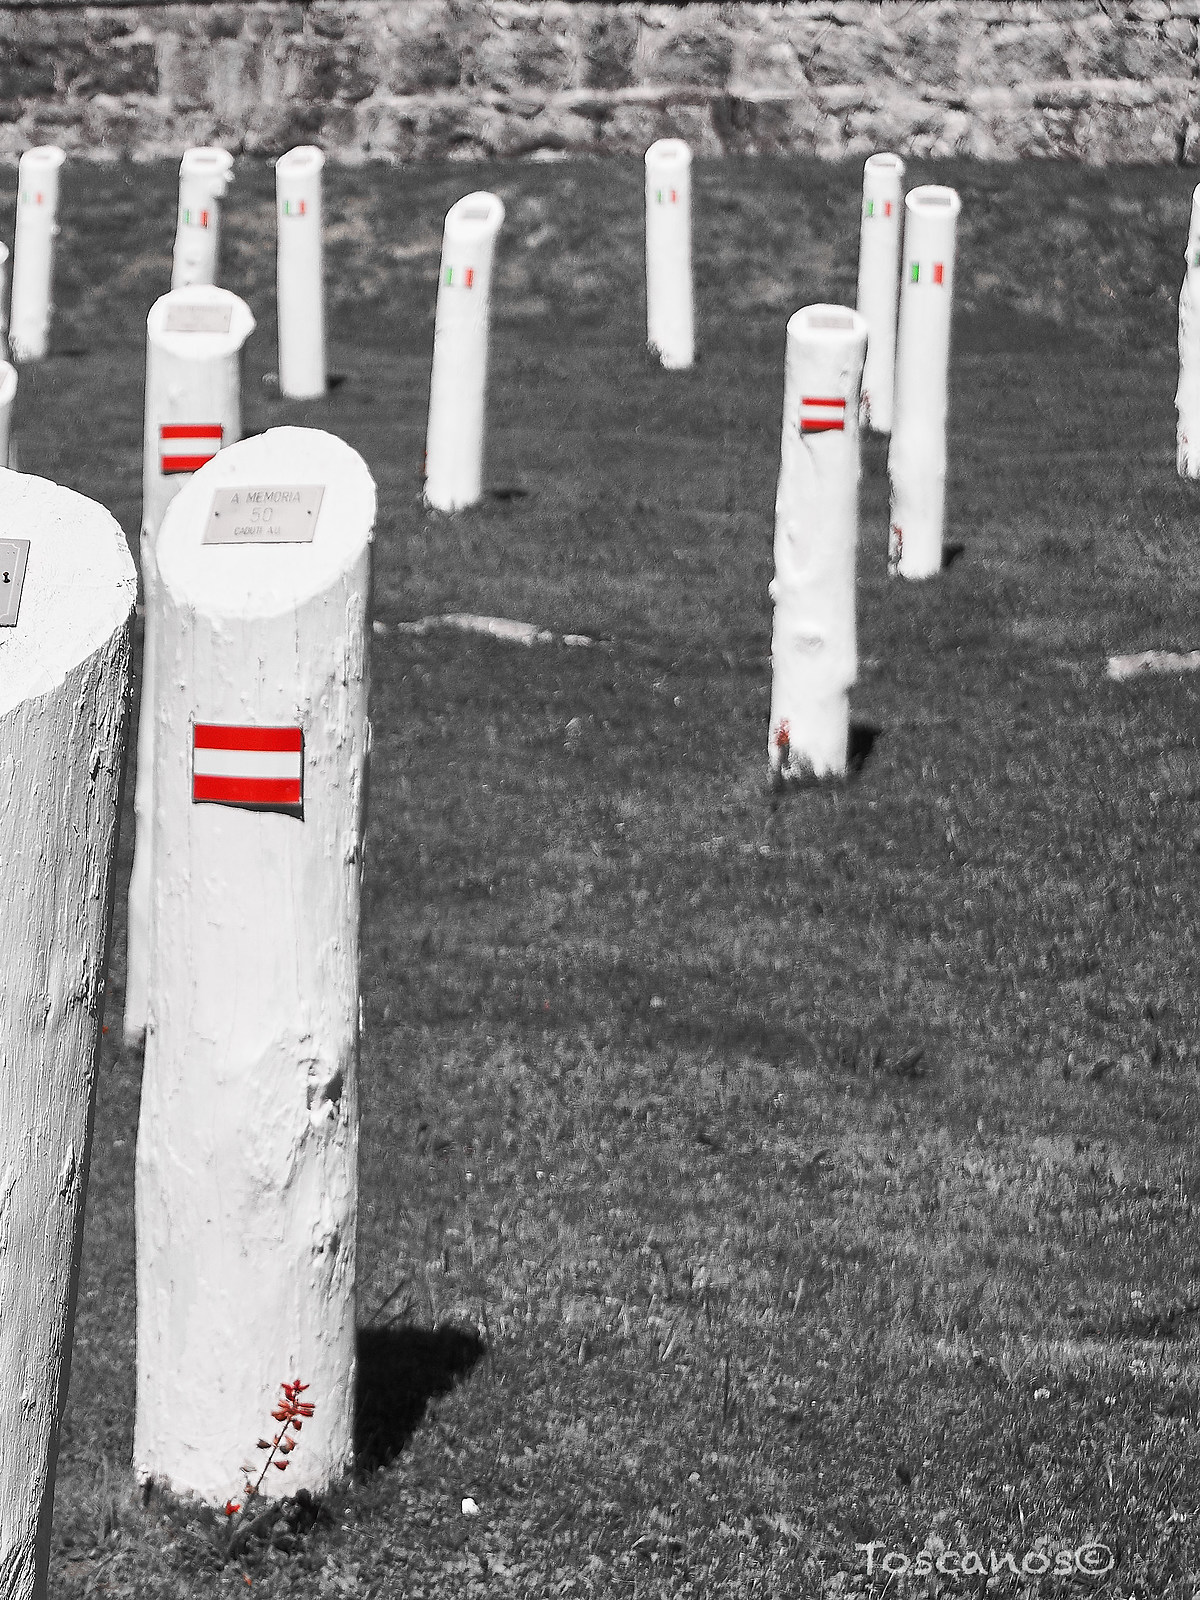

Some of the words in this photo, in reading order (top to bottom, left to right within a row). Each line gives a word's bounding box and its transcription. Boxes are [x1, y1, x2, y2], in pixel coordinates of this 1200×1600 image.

[231, 493, 239, 504] A
[246, 491, 301, 503] MEMORIA
[251, 507, 273, 522] 50
